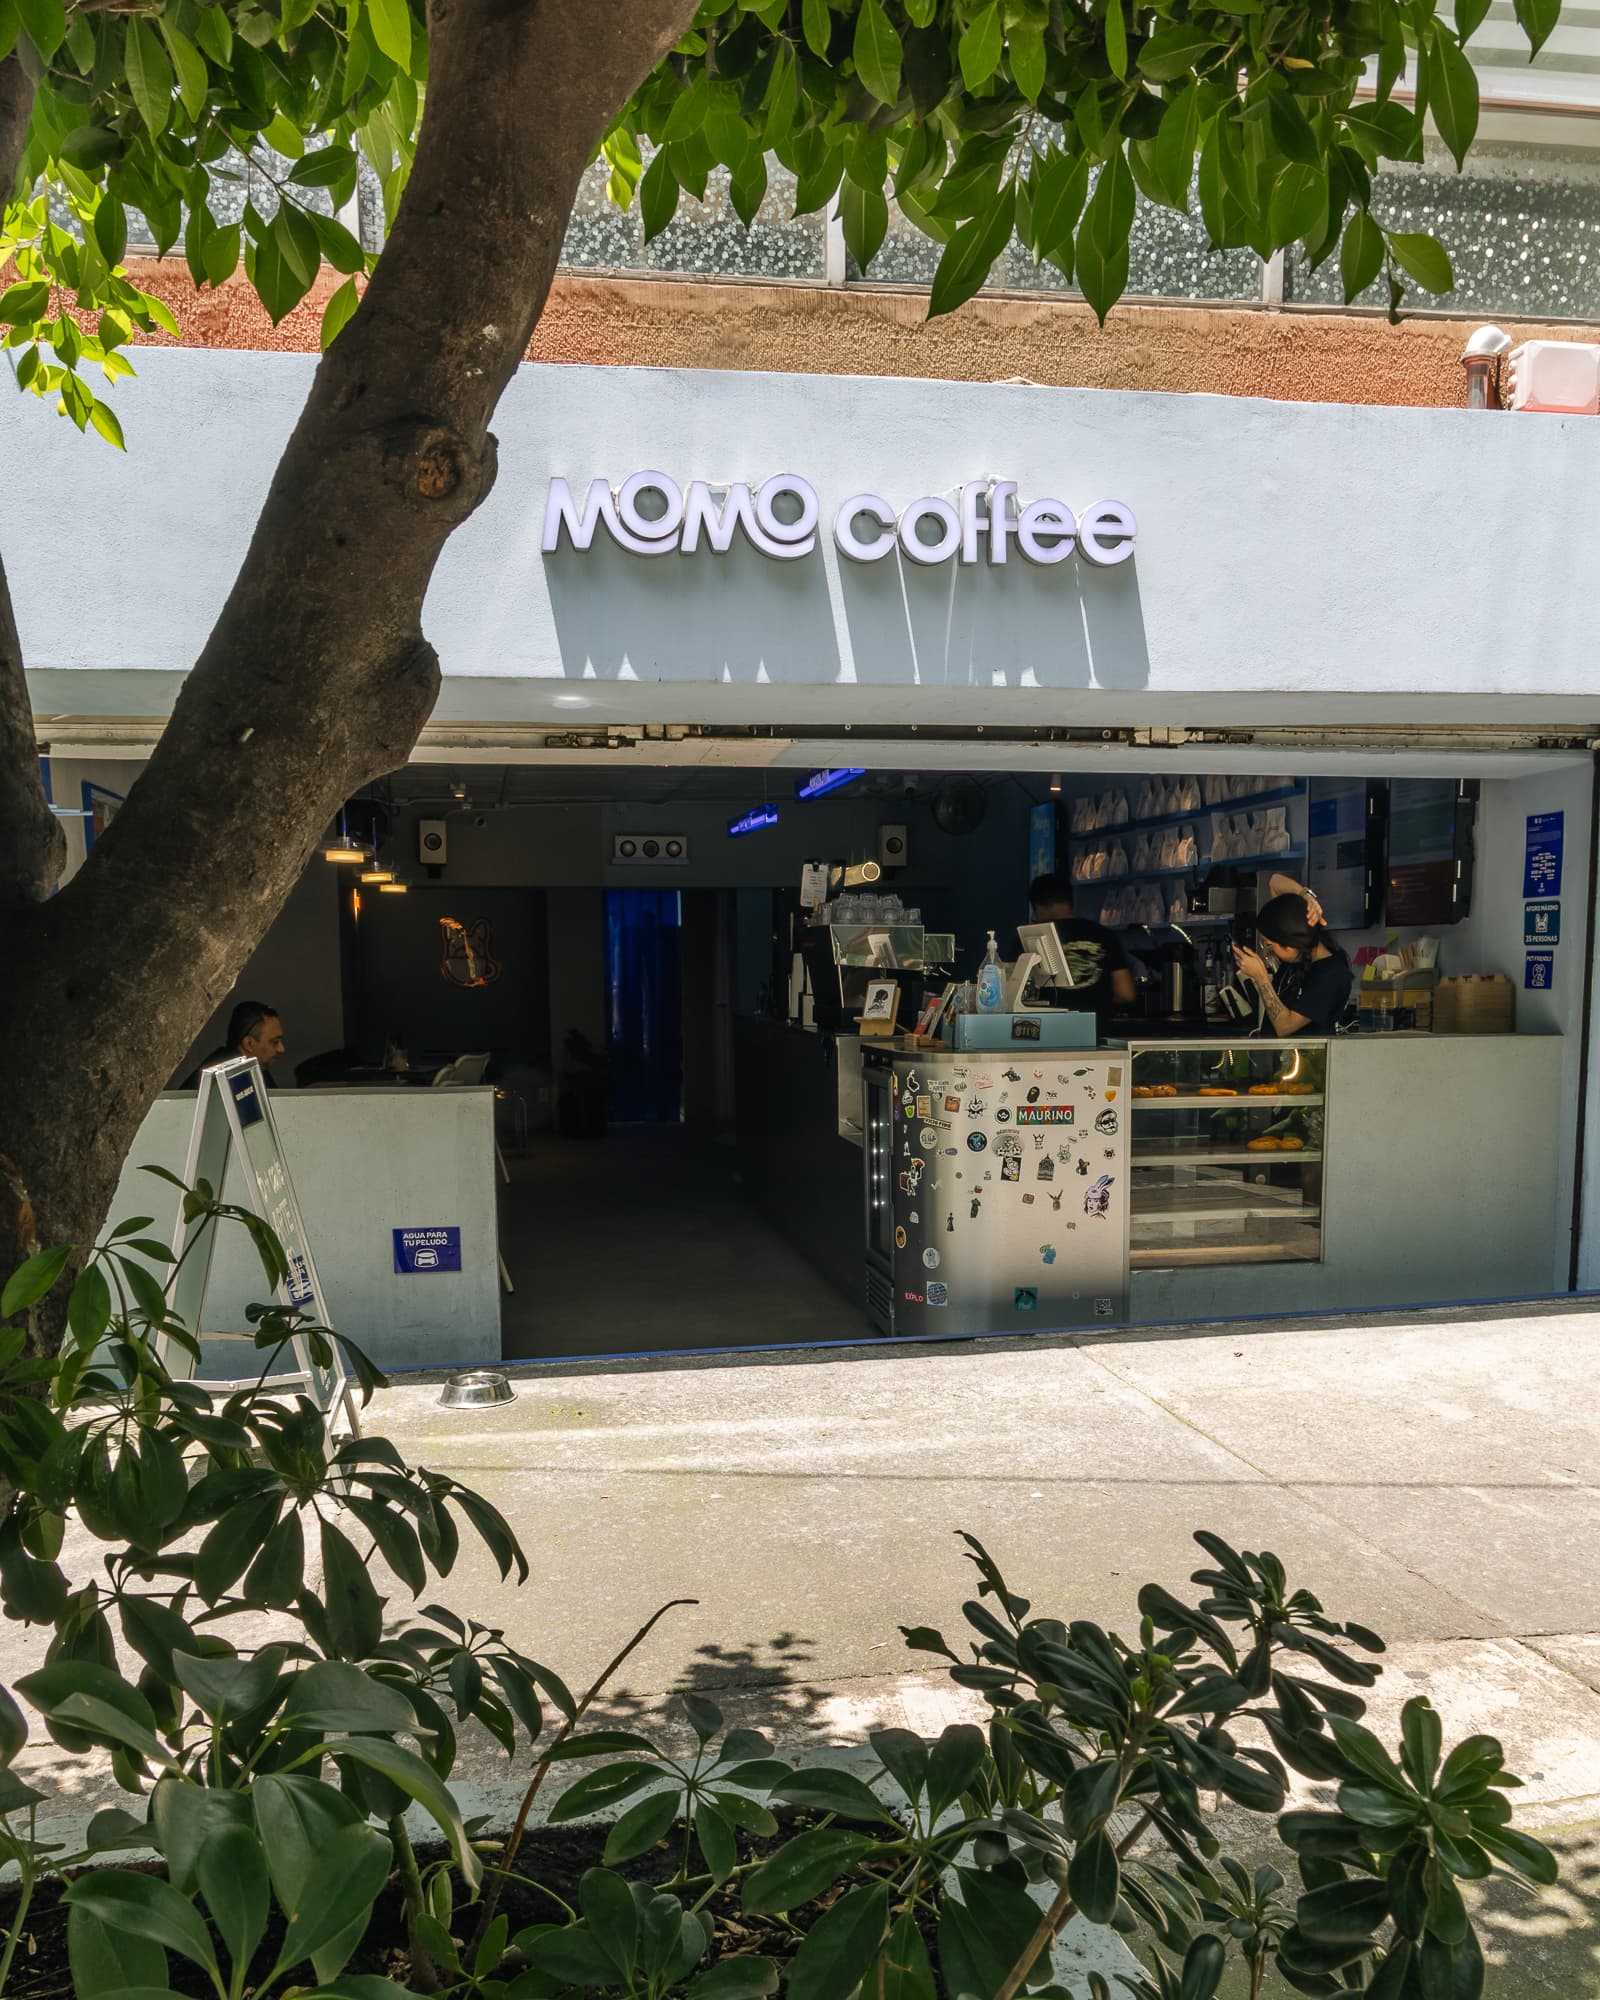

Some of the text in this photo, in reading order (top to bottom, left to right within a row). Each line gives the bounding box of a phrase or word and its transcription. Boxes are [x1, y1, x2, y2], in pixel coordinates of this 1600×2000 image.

[541, 469, 1137, 567] MOMO coffee
[1018, 1110, 1073, 1121] MAURINO
[426, 1231, 448, 1239] PARA
[415, 1238, 448, 1246] PELUDO
